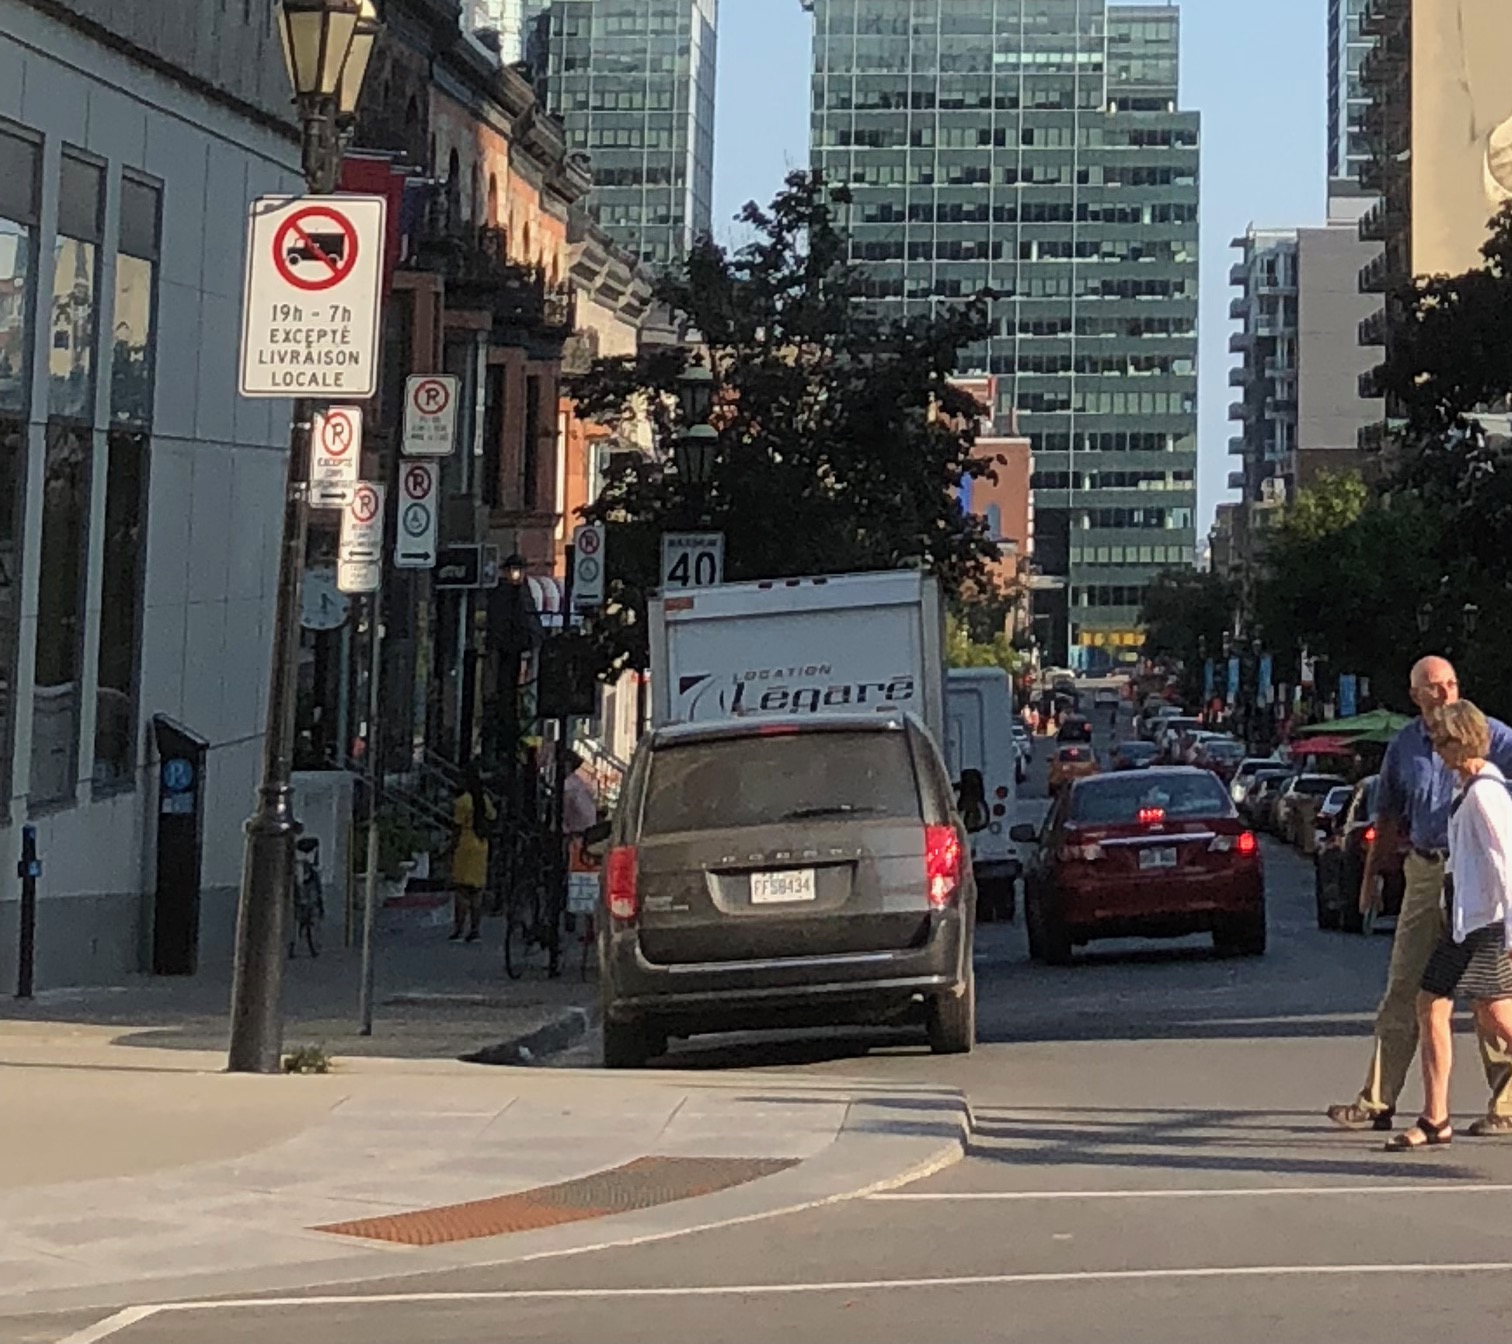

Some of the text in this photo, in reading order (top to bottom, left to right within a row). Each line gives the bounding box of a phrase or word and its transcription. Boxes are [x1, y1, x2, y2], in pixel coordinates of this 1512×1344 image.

[271, 303, 302, 322] 19h
[329, 304, 352, 322] 7h
[269, 325, 351, 345] EXCEPTÉ
[258, 349, 360, 365] LIVRAISON
[271, 371, 345, 387] LOCALE
[667, 552, 717, 586] 40
[733, 664, 833, 684] LOCATION
